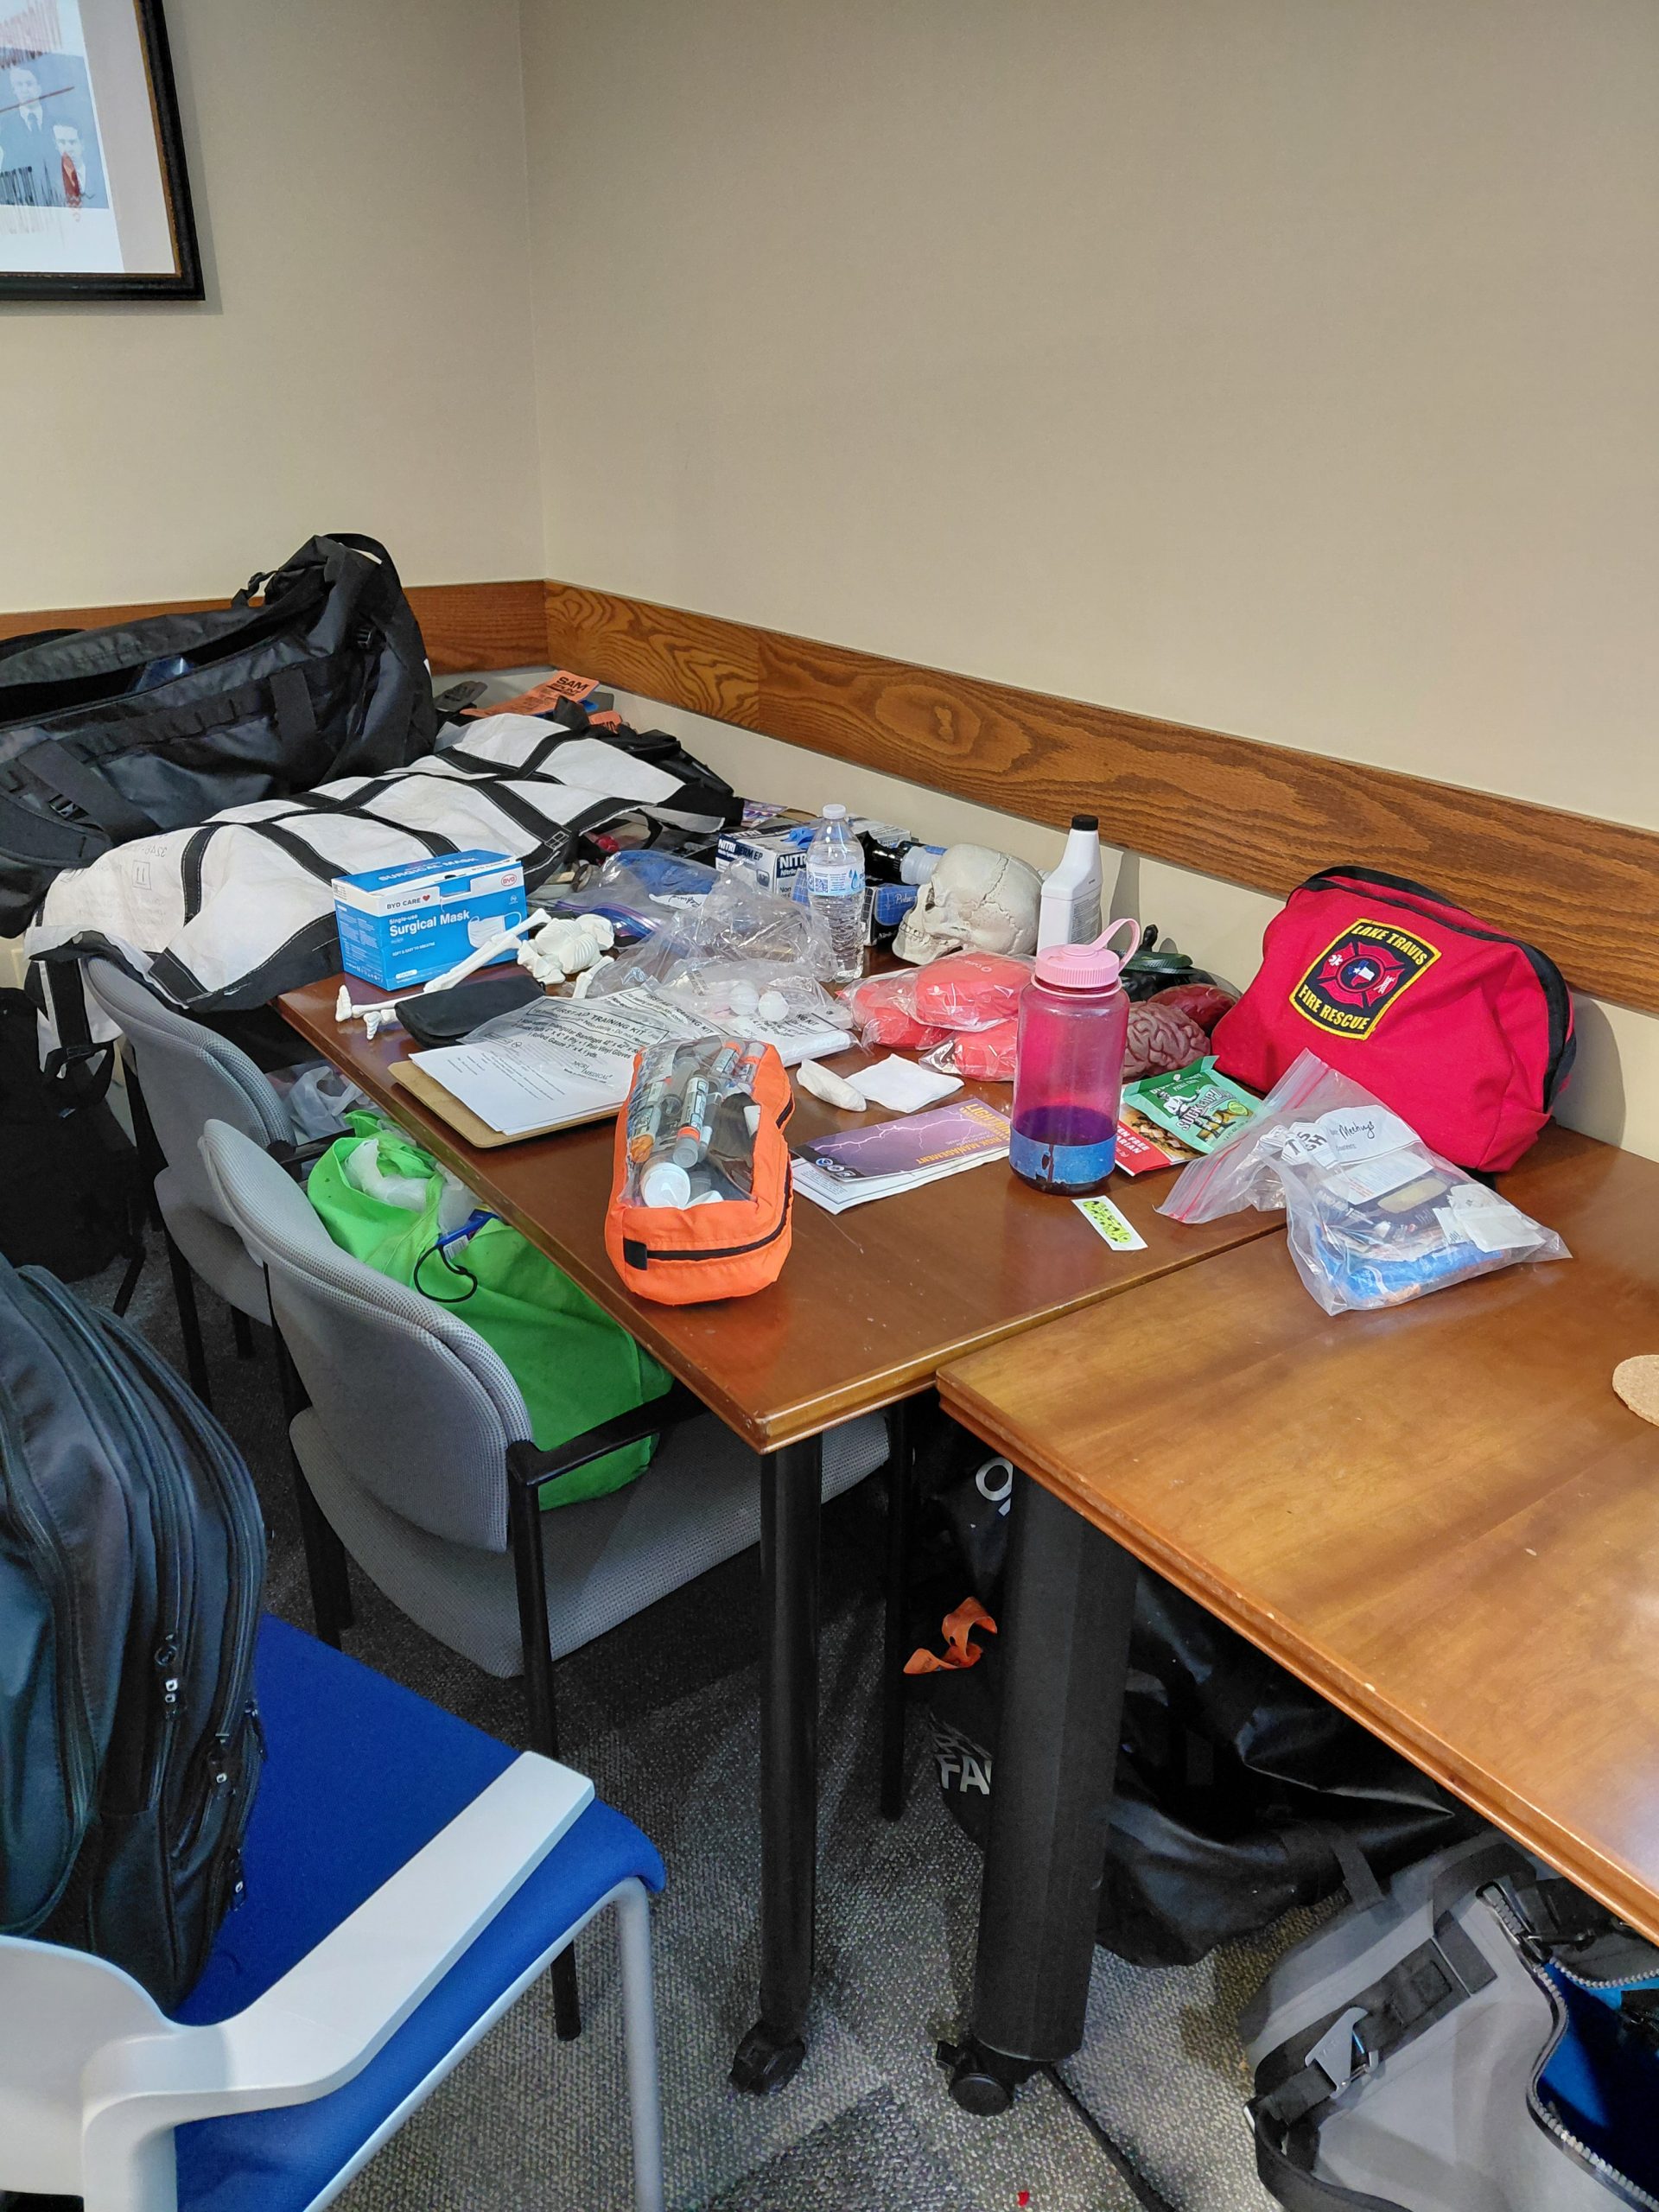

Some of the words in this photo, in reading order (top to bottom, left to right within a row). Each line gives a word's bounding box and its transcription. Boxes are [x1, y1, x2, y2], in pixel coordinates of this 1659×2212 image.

[556, 677, 588, 691] SAM
[754, 851, 763, 861] EP
[389, 914, 418, 925] Single-use
[389, 917, 437, 937] Surgical
[440, 910, 470, 925] Mask
[1351, 925, 1389, 941] LAKE
[1386, 932, 1428, 966] TRAVIS
[1298, 983, 1321, 1013] FIRE
[1319, 1005, 1370, 1031] RESCUE
[591, 1014, 630, 1029] TRAINING
[630, 1027, 647, 1036] KIT
[701, 1026, 714, 1034] KIT
[548, 1038, 566, 1047] Gauze
[575, 1032, 603, 1044] Bandages
[612, 1049, 632, 1059] Gloves
[982, 1136, 1003, 1147] RISK
[1127, 1137, 1150, 1151] FREE
[916, 1142, 980, 1164] MANAGEMENT
